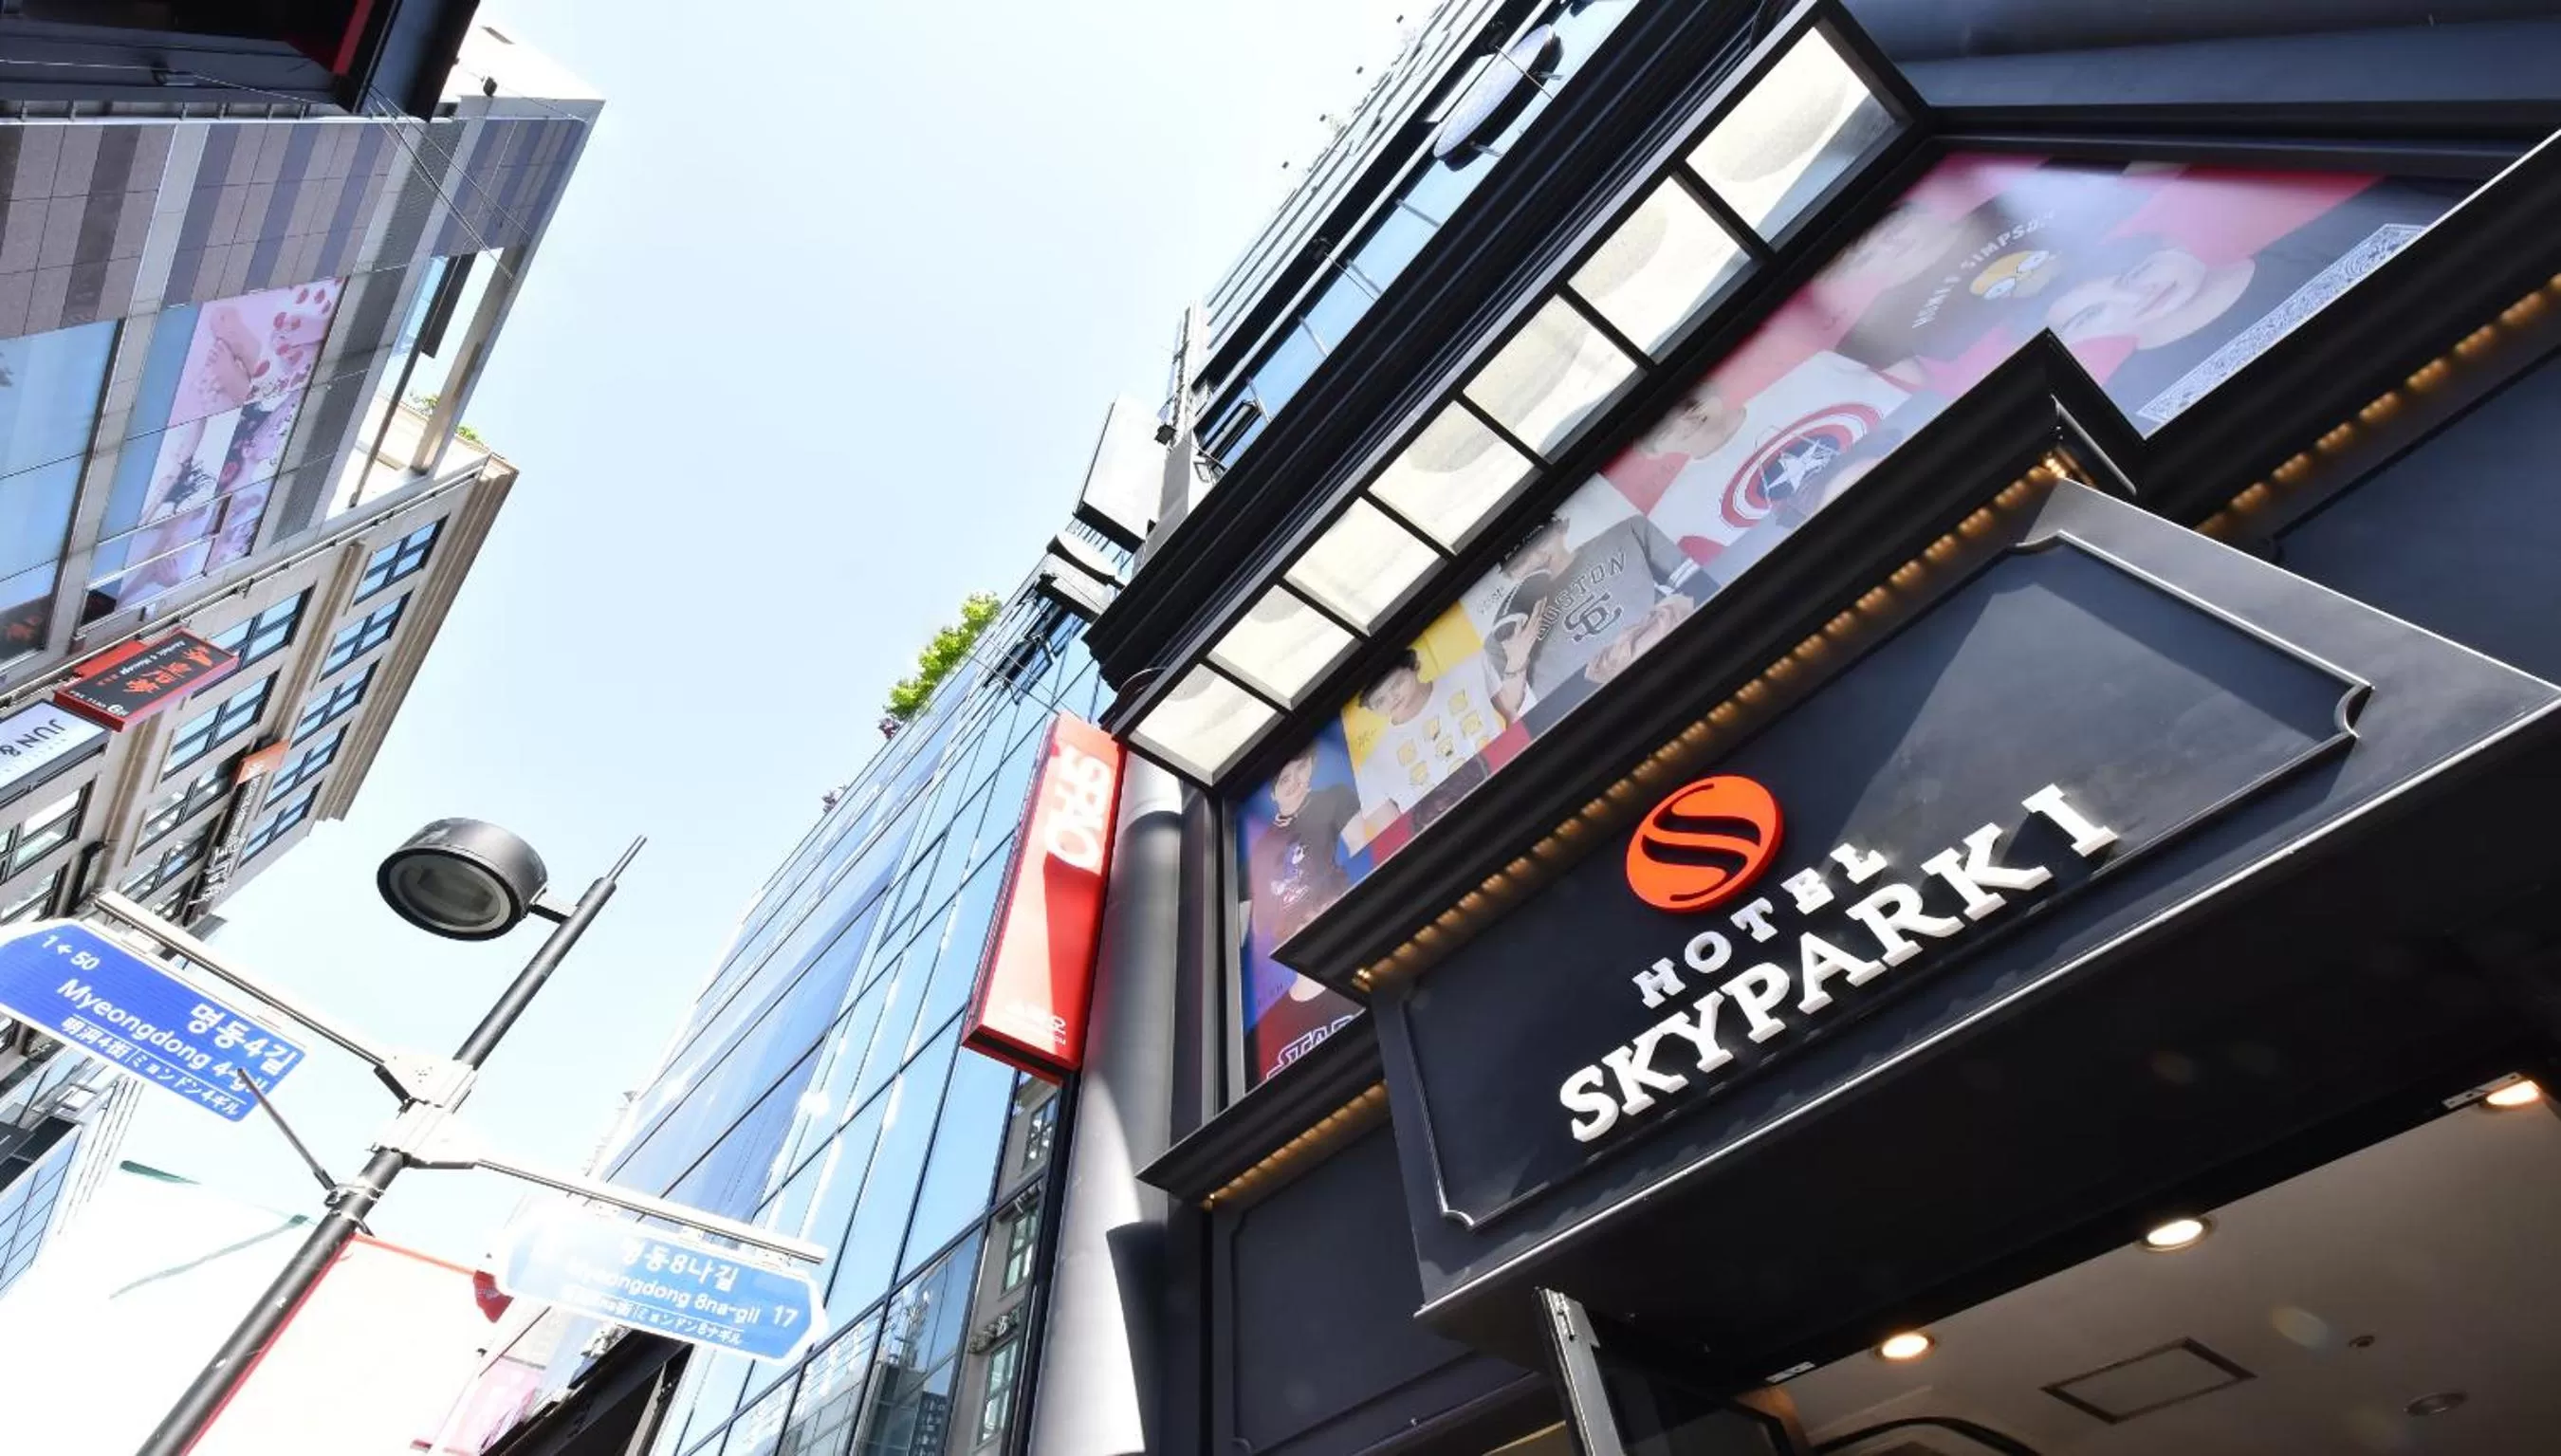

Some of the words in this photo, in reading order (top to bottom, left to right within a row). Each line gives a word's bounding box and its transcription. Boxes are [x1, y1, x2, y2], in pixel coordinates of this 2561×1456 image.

[42, 934, 59, 949] 1
[70, 950, 101, 971] 50
[1631, 842, 1889, 1008] HOTEL
[1557, 821, 2054, 1142] SKYPARK
[57, 978, 212, 1069] Myeongdong
[188, 1003, 298, 1077] 명동4길
[693, 1292, 762, 1325] 8na-gil
[772, 1304, 799, 1328] 17
